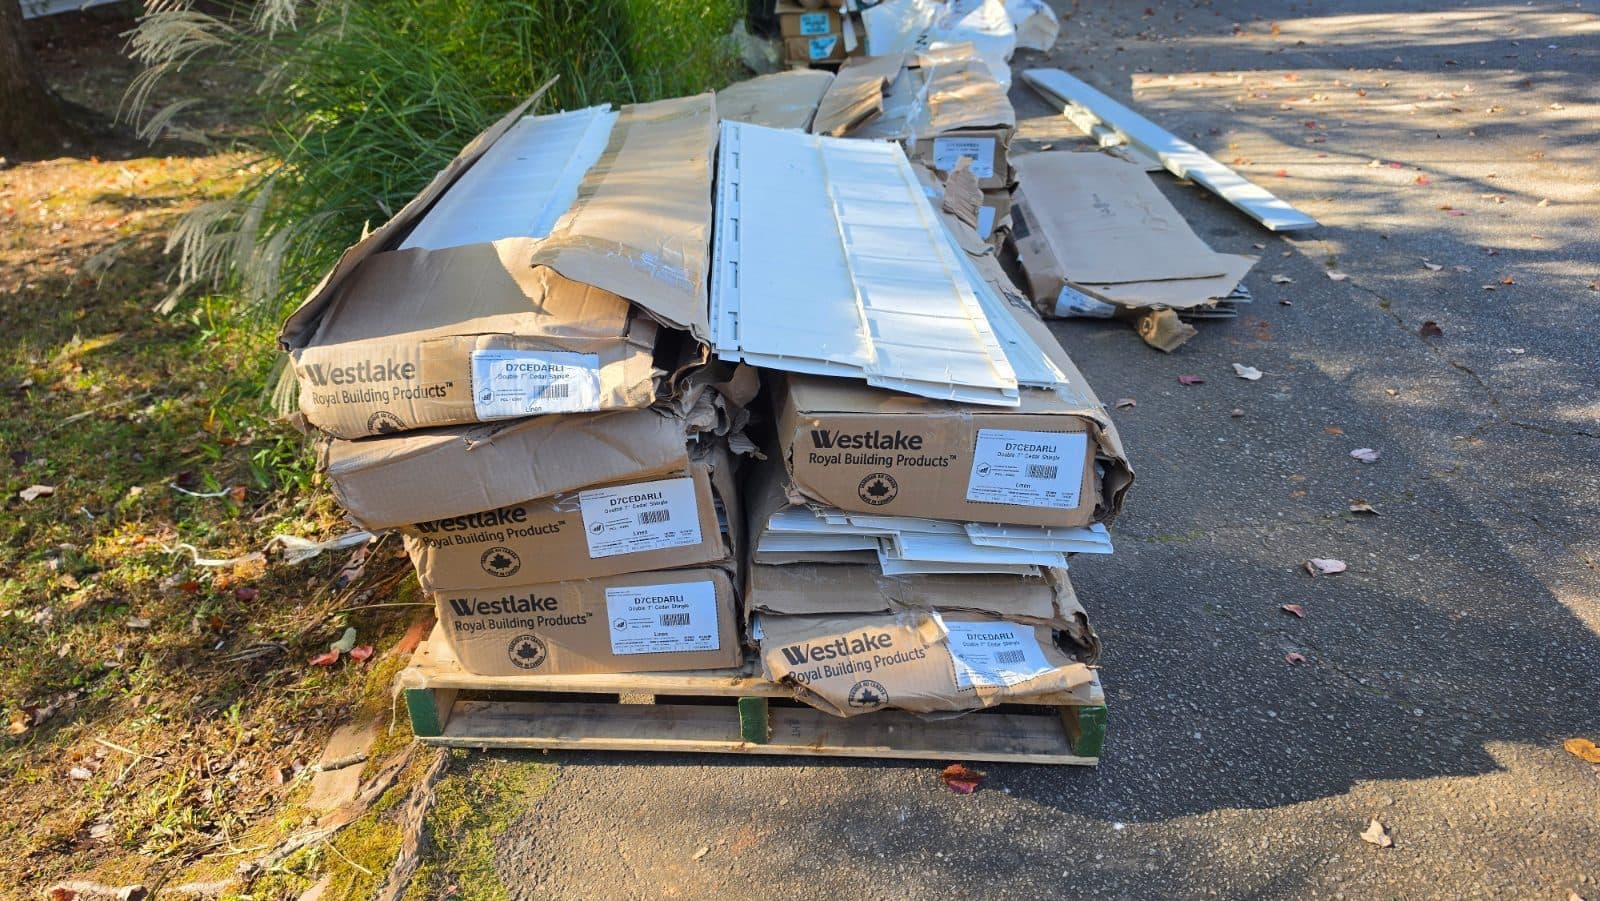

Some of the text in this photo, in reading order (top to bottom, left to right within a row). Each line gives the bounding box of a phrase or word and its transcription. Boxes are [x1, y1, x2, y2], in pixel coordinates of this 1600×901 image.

[305, 358, 416, 386] Westlake
[506, 363, 564, 372] D7CEDARLI
[312, 391, 338, 408] Royal
[342, 388, 390, 404] Building
[810, 430, 923, 450] Westlake
[1005, 442, 1057, 453] D7CEDARLI
[808, 452, 842, 466] Royal
[844, 452, 893, 468] Building
[610, 492, 662, 506] D7CEDARLI
[415, 507, 528, 534] Westlake
[422, 536, 454, 549] Royal
[456, 530, 504, 545] Building
[450, 594, 558, 616] Westlake
[634, 595, 684, 605] D7CEDARLI
[454, 620, 486, 634] Royal
[489, 617, 534, 630] Building
[781, 633, 893, 666] Westlake
[789, 667, 822, 685] Royal
[824, 659, 872, 678] Building
